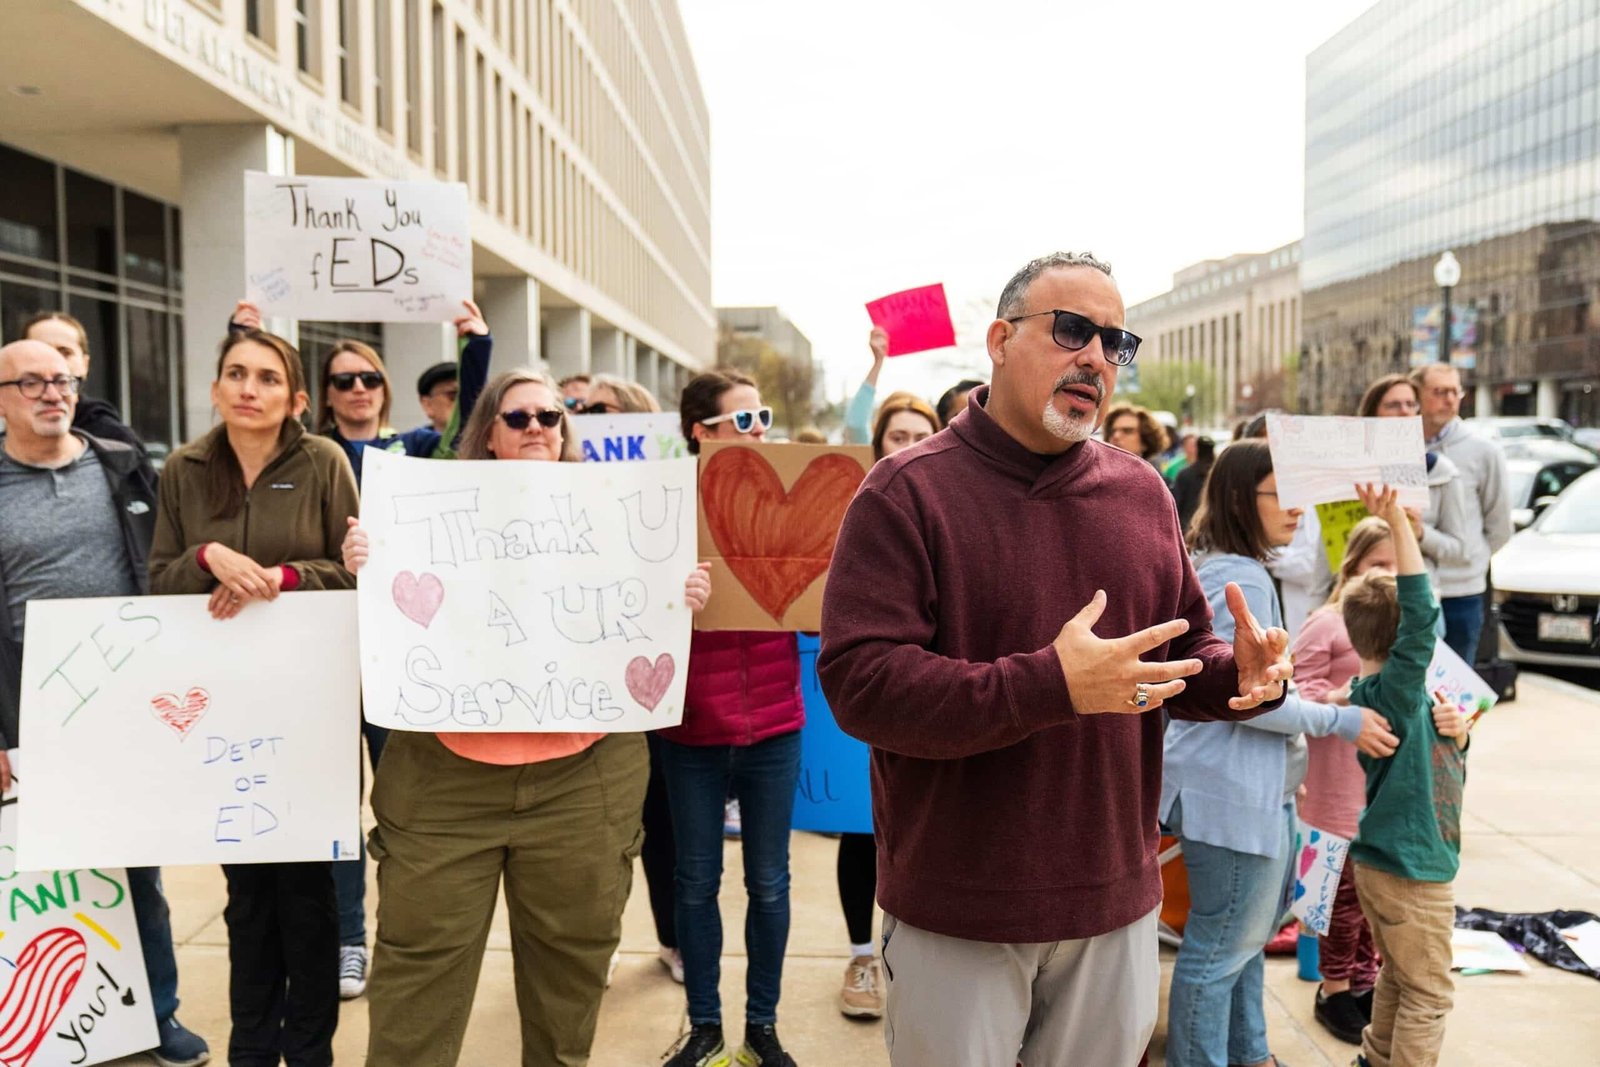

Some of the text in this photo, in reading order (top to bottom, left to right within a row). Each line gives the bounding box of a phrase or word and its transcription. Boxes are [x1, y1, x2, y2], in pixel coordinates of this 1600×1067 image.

[276, 184, 422, 232] Thank You
[309, 237, 419, 290] fEDs
[582, 435, 646, 462] ANK
[391, 485, 682, 567] Thank U
[542, 577, 653, 644] UR
[38, 601, 161, 728] IES
[394, 644, 625, 726] Service
[203, 736, 285, 764] DEPT
[235, 774, 267, 792] OF
[215, 802, 279, 843] ED
[9, 868, 125, 922] ANTS
